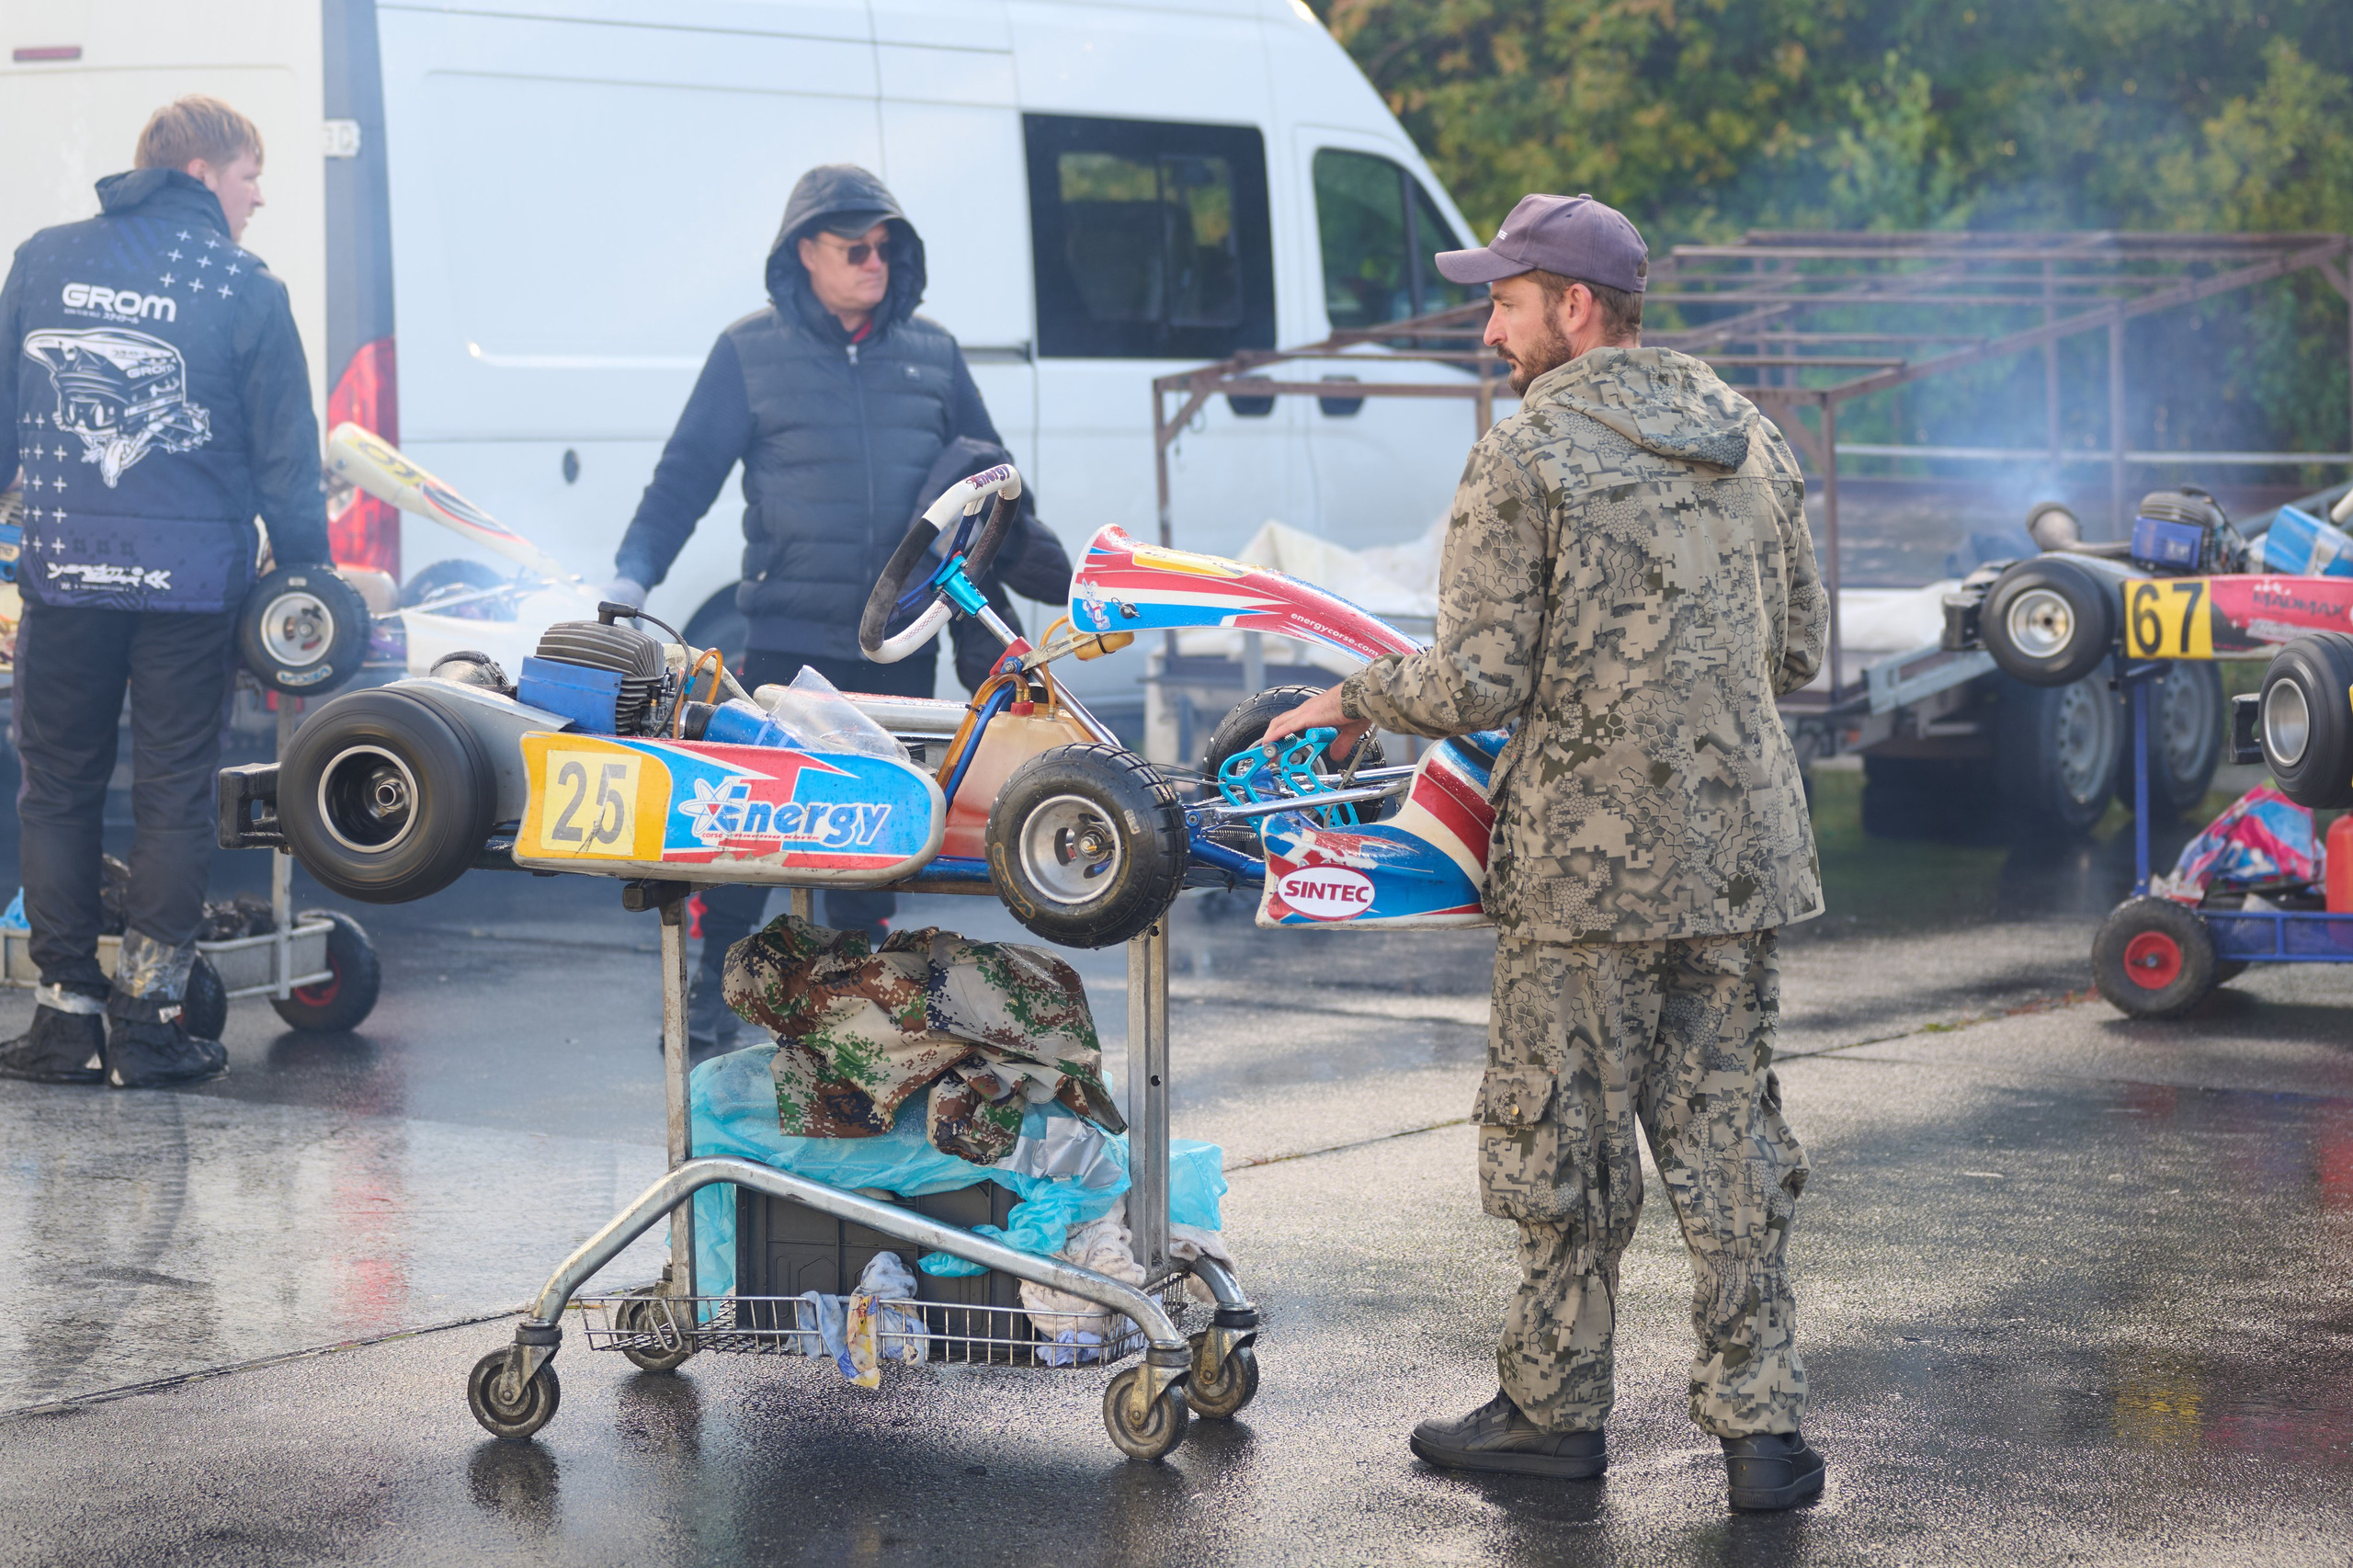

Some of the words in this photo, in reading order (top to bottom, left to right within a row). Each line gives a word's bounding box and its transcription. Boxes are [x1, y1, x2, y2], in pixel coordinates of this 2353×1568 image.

[62, 282, 176, 323] GROM
[1290, 612, 1379, 656] energycorse.com
[2131, 582, 2204, 656] 67
[551, 761, 627, 845] 25
[709, 783, 892, 847] Energy
[992, 842, 1036, 919] VEGA
[1284, 880, 1370, 903] SINTEC
